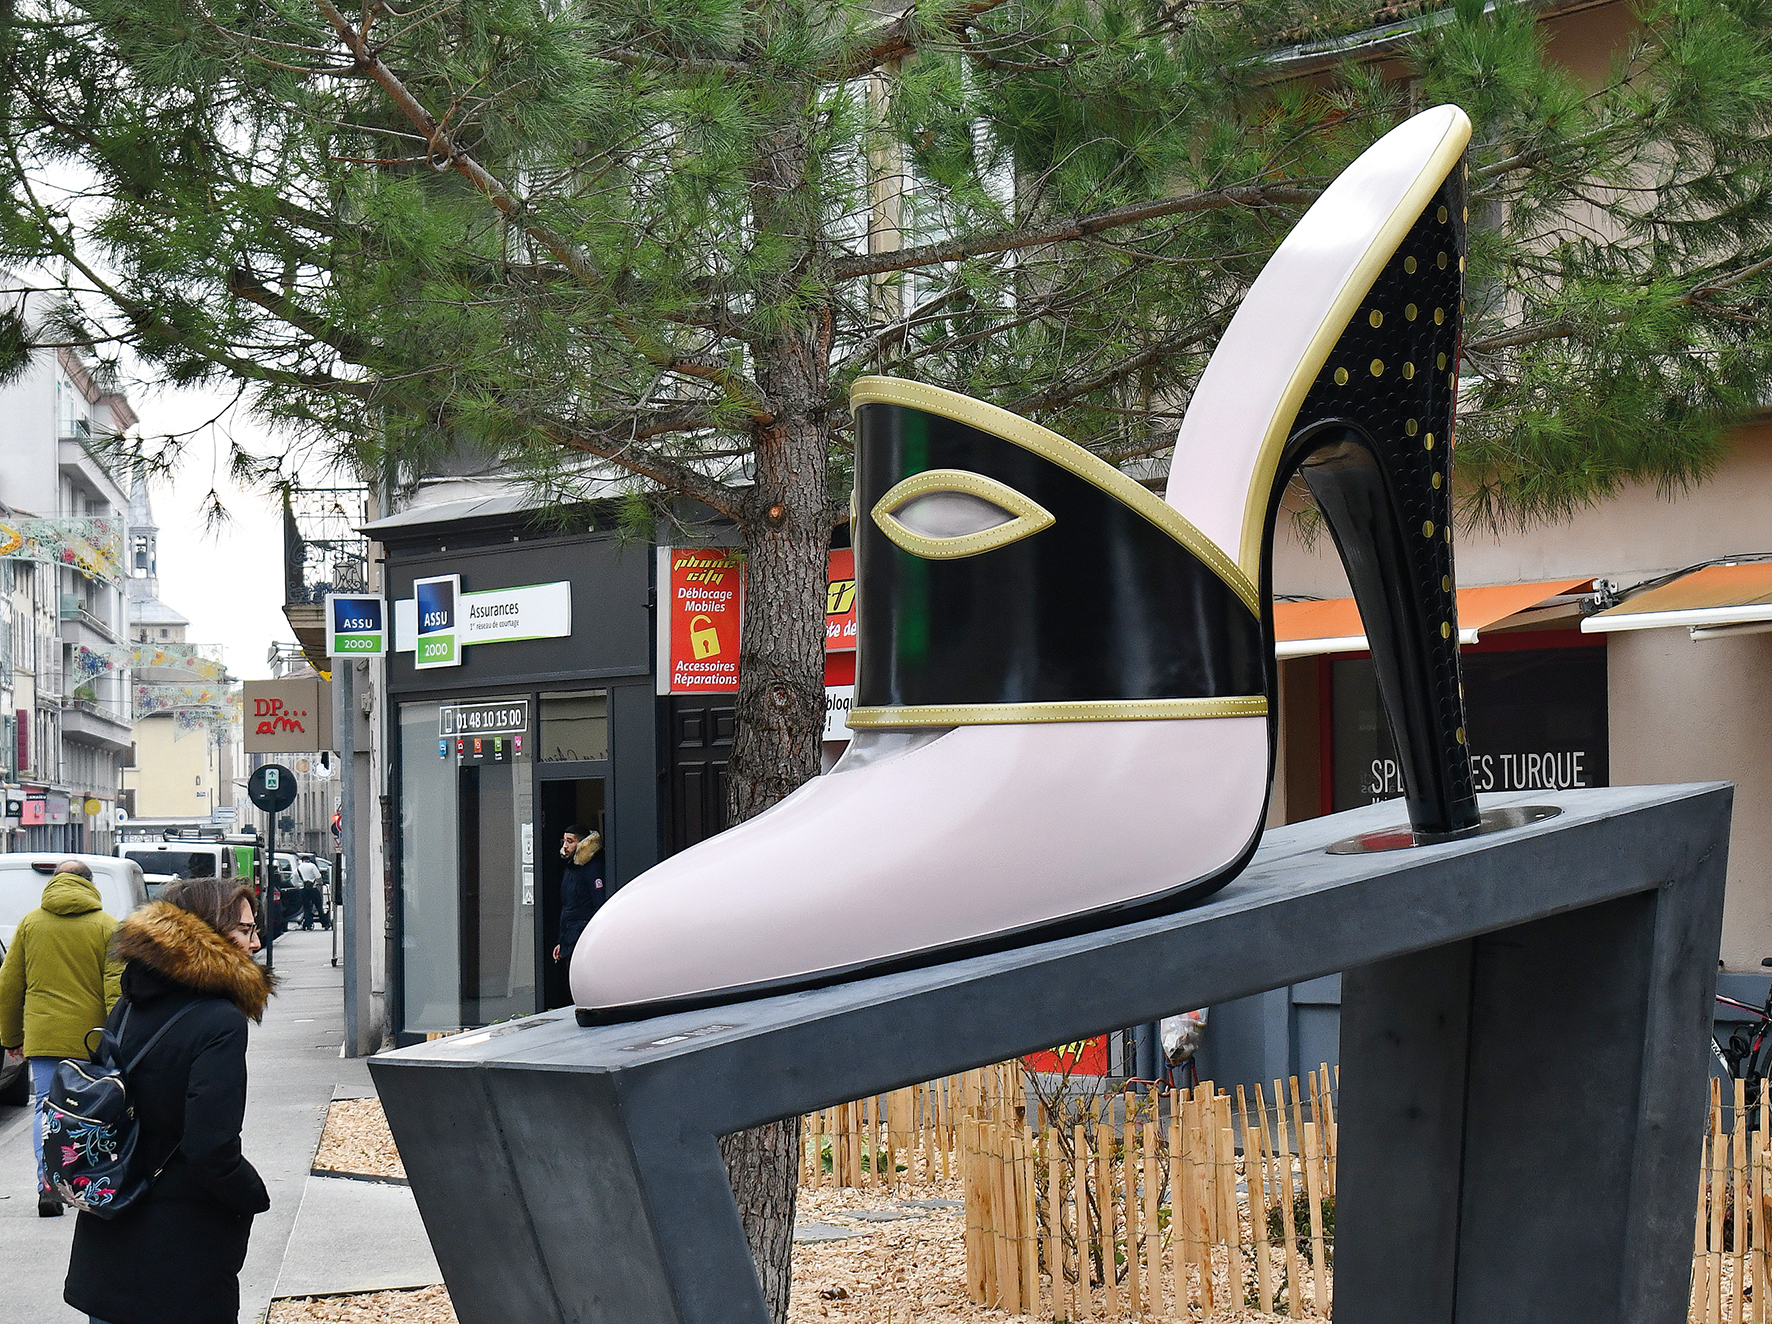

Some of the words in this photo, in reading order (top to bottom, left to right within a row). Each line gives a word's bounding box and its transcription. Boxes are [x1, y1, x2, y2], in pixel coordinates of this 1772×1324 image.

[686, 569, 725, 585] city
[677, 588, 733, 600] Déblocage
[469, 602, 520, 619] Assurances
[685, 600, 726, 612] Mobiles
[343, 618, 373, 629] ASSU
[424, 610, 448, 627] ASSU
[492, 620, 499, 629] de
[499, 619, 520, 629] courtage
[843, 619, 857, 637] de
[344, 639, 373, 649] 2000
[425, 642, 448, 656] 2000
[675, 660, 735, 672] Accessoires
[674, 673, 737, 687] Réparations
[256, 716, 305, 735] am
[456, 713, 468, 729] 01
[469, 711, 481, 728] 48
[483, 711, 494, 728] 10
[496, 709, 508, 727] 15
[509, 708, 522, 726] 00
[1500, 751, 1586, 791] TURQUE
